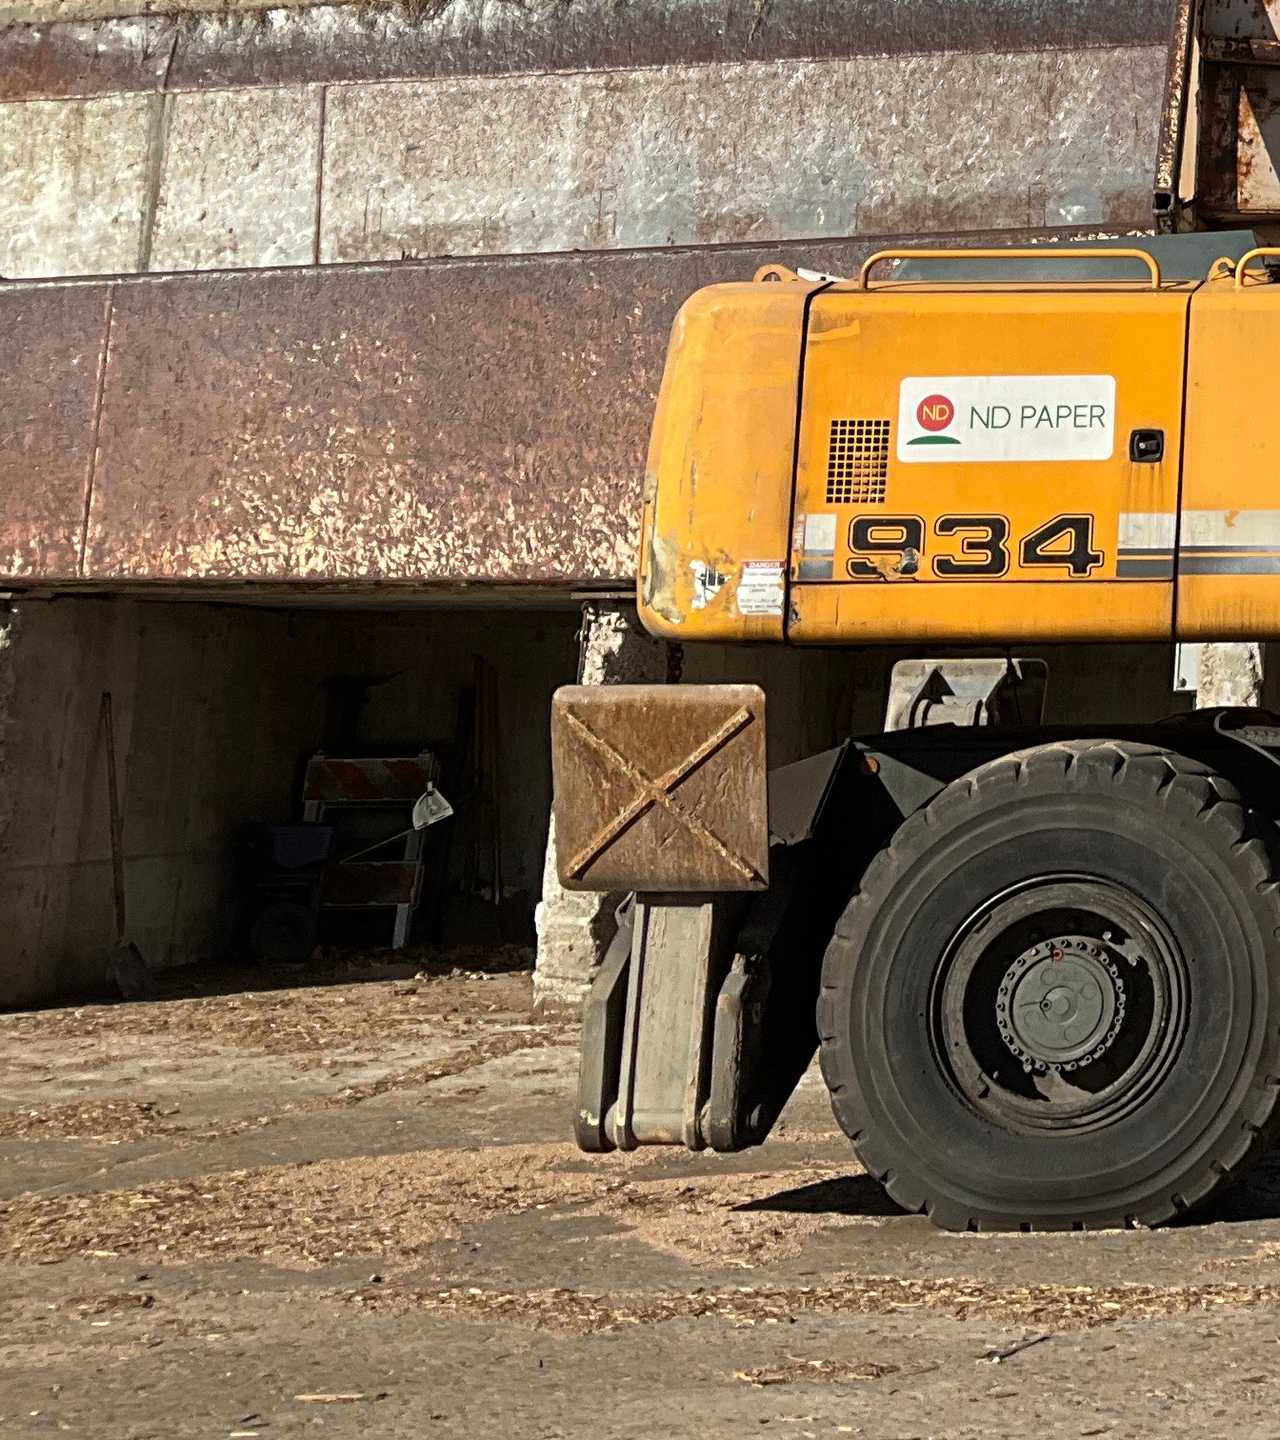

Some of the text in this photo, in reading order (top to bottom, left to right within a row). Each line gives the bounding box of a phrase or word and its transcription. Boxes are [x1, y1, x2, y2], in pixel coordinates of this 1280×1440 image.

[922, 404, 950, 421] ND
[969, 405, 1106, 429] ND PAPER
[846, 514, 1104, 579] 934
